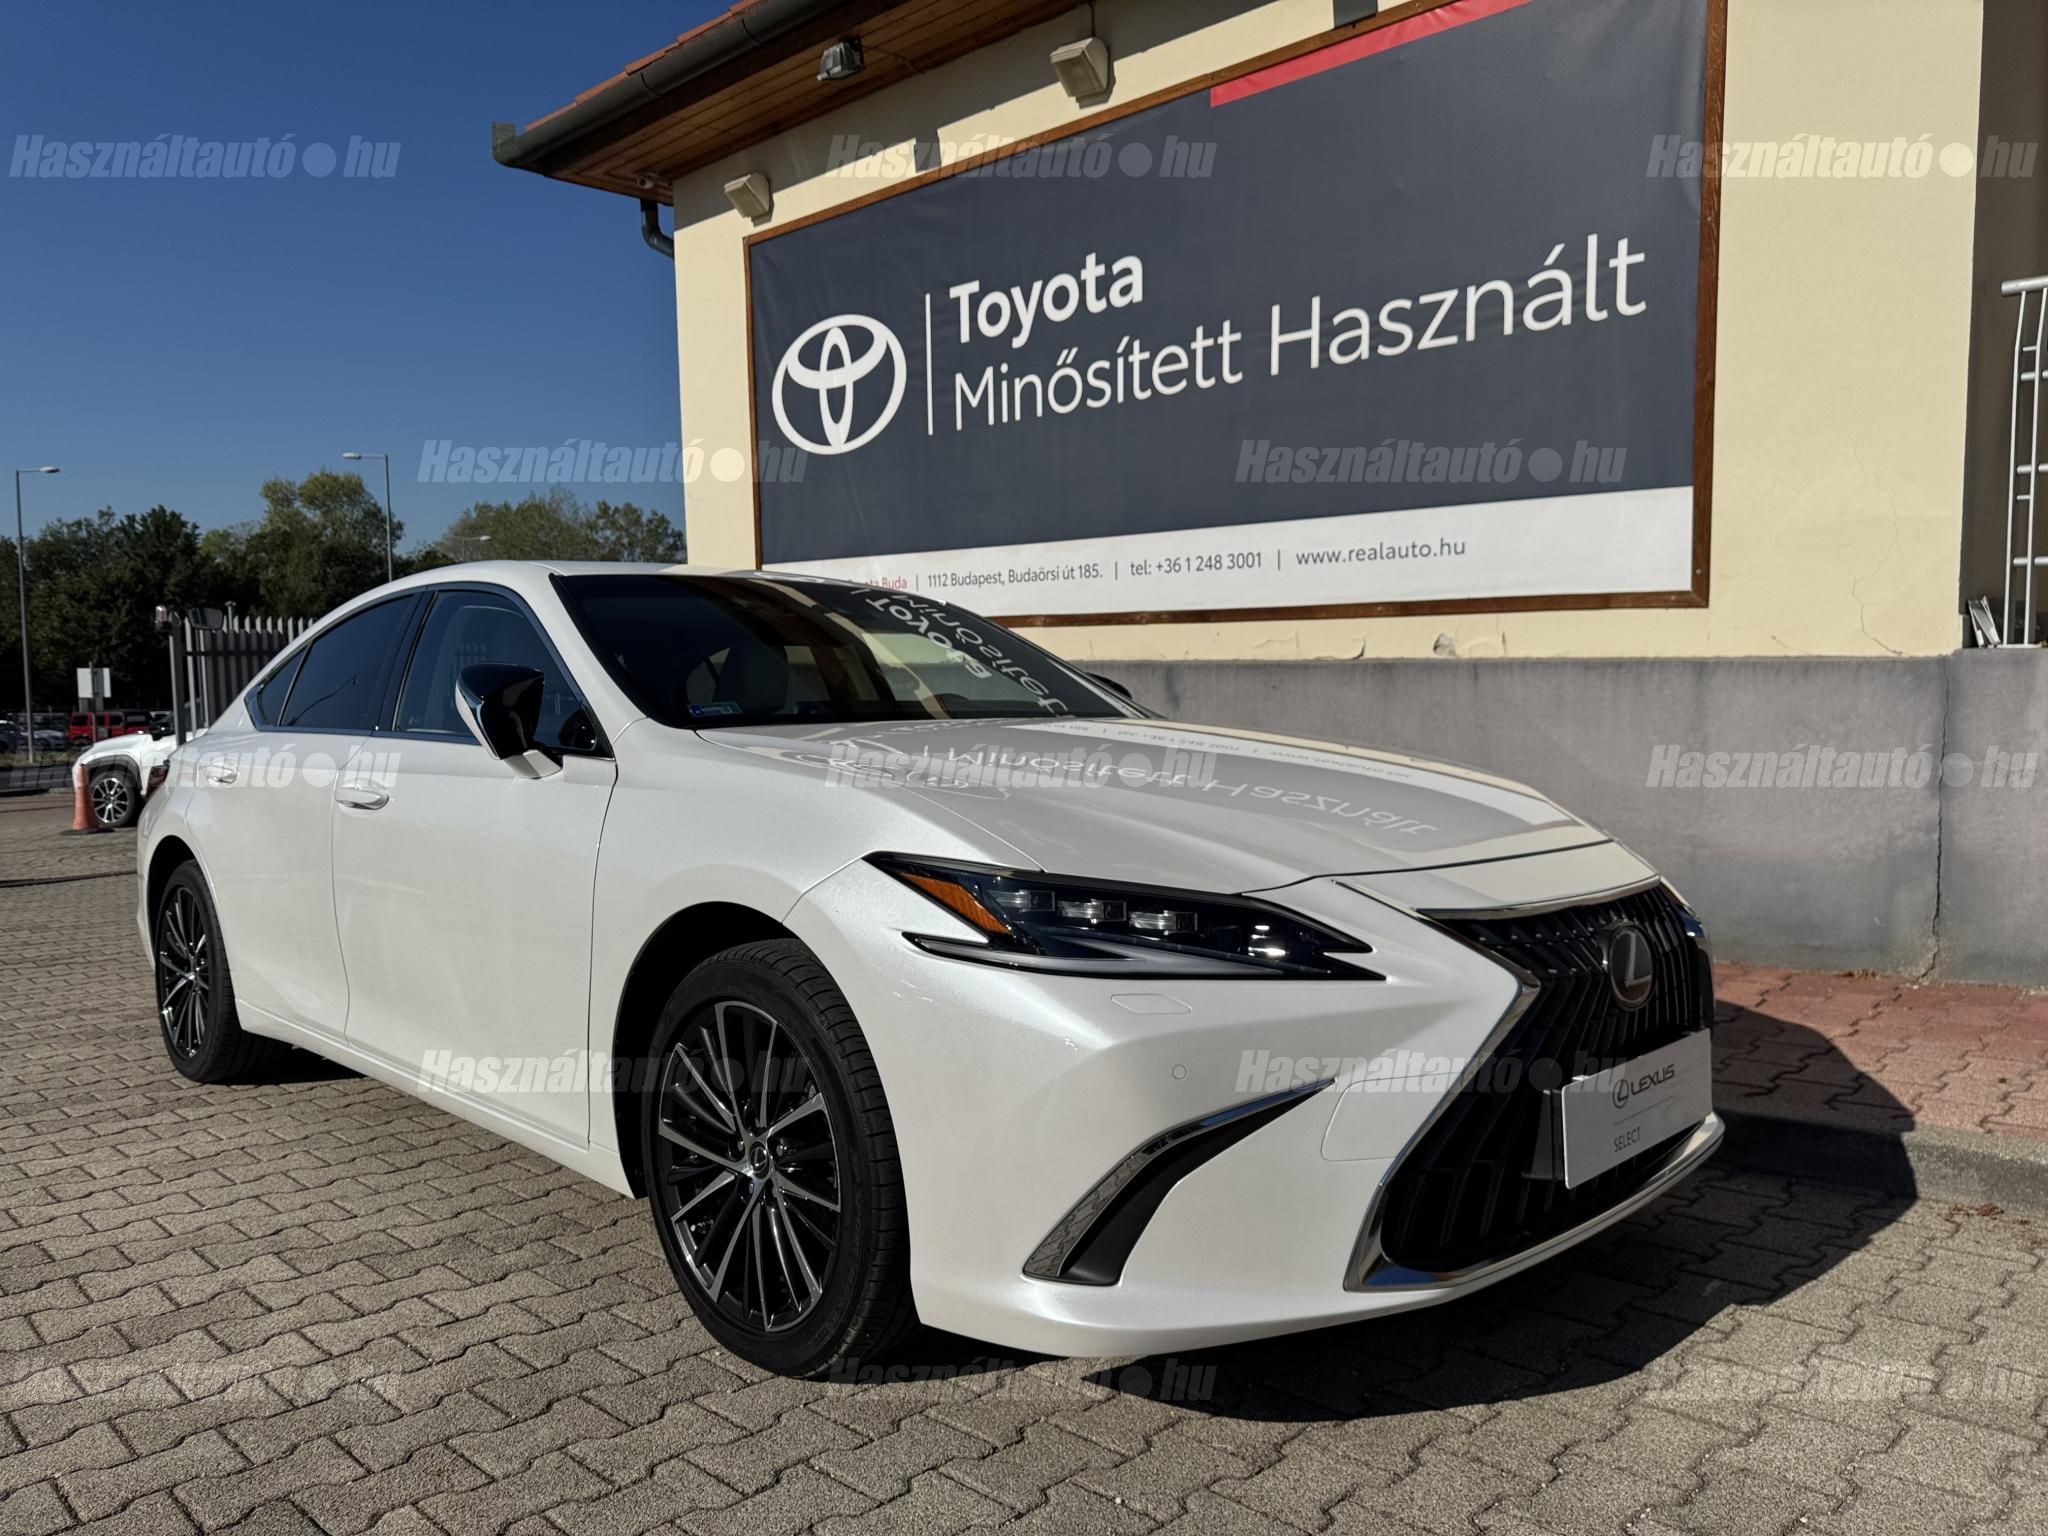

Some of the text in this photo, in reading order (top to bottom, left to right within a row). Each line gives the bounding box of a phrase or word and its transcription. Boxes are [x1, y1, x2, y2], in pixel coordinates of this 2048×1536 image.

[949, 252, 1144, 349] Toyota
[955, 233, 1647, 431] Minősített Használt
[927, 573, 948, 588] 1112
[951, 571, 1006, 589] Budapest,
[1008, 565, 1060, 583] Budaörsi
[1062, 565, 1076, 580] út
[1079, 563, 1103, 579] 185.
[1130, 559, 1152, 576] tel:
[1156, 557, 1182, 574] +36
[1185, 556, 1191, 572] 1
[1195, 554, 1223, 572] 248
[1226, 551, 1262, 570] 3001
[1296, 538, 1466, 566] www.realauto.hu
[1631, 1064, 1676, 1096] LEXUS
[1613, 1126, 1641, 1152] SELECT
